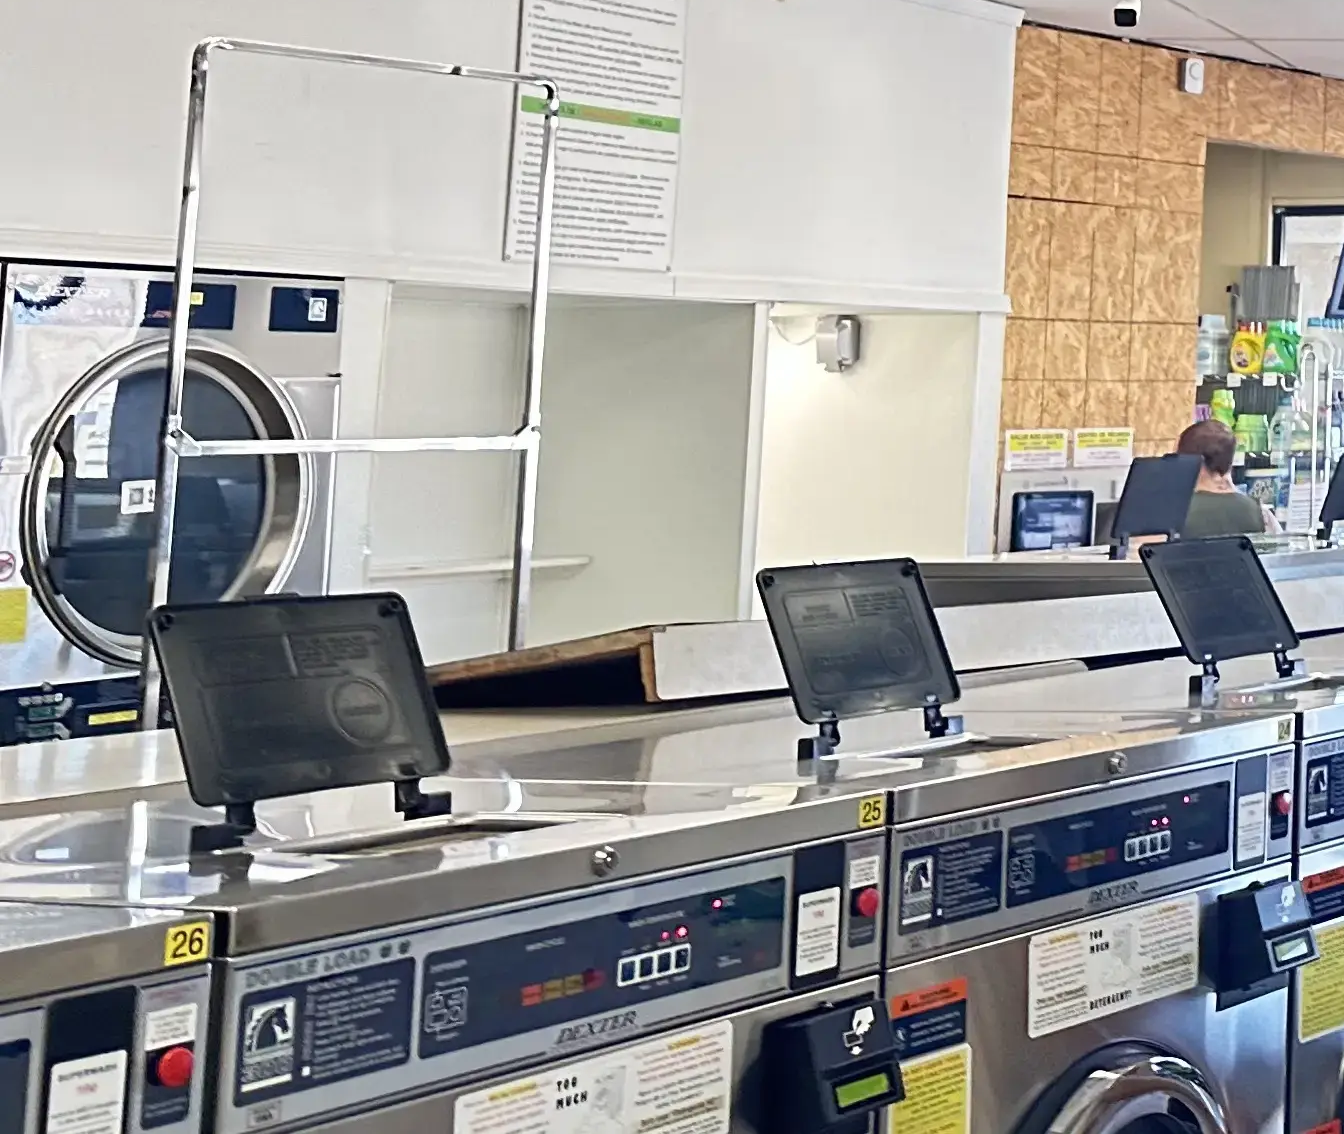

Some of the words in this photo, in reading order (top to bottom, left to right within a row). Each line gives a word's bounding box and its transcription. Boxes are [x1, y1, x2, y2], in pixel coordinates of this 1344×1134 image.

[862, 800, 881, 822] 25
[172, 928, 203, 959] 26
[1089, 929, 1104, 942] TOO
[245, 960, 318, 989] DOUBLE
[323, 947, 371, 973] LOAD
[555, 1010, 639, 1045] DEXTER
[556, 1076, 578, 1093] TOO
[556, 1090, 589, 1111] MUCH
